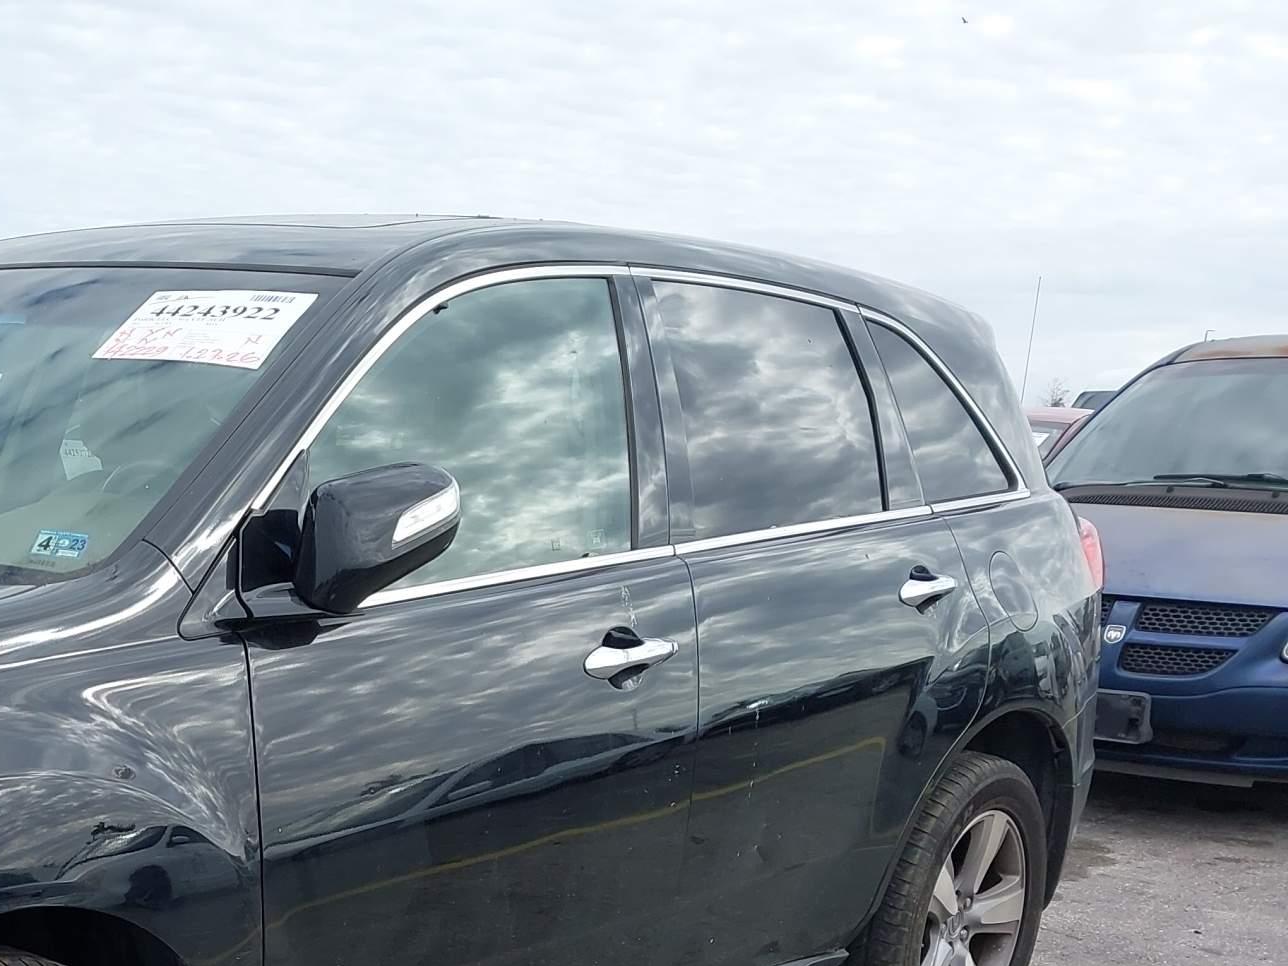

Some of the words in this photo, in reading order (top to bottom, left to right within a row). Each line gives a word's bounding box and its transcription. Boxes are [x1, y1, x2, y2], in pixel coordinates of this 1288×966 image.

[150, 304, 281, 321] 44243922
[37, 535, 53, 551] 4
[71, 538, 87, 551] 23
